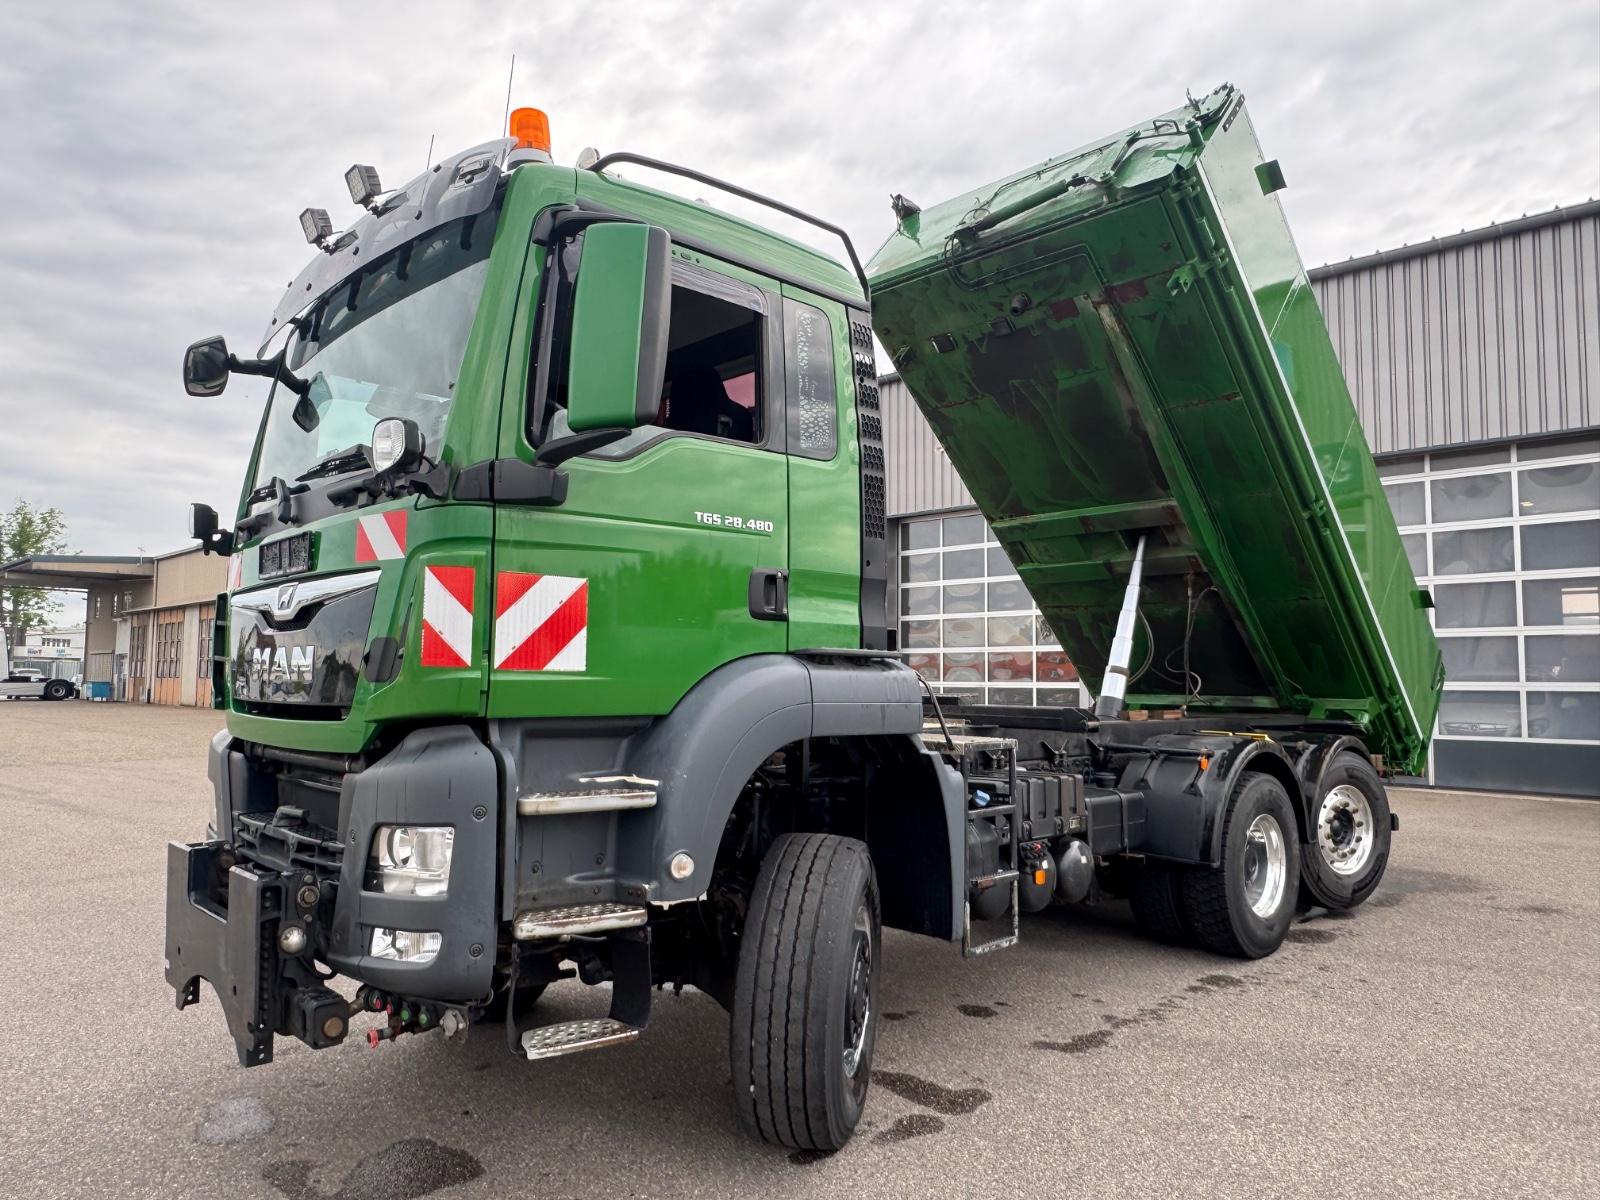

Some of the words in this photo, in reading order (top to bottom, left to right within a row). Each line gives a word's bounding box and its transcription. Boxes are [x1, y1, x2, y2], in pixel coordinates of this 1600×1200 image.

[694, 511, 722, 525] TGS
[724, 516, 774, 532] 28.480
[252, 645, 315, 681] MAN
